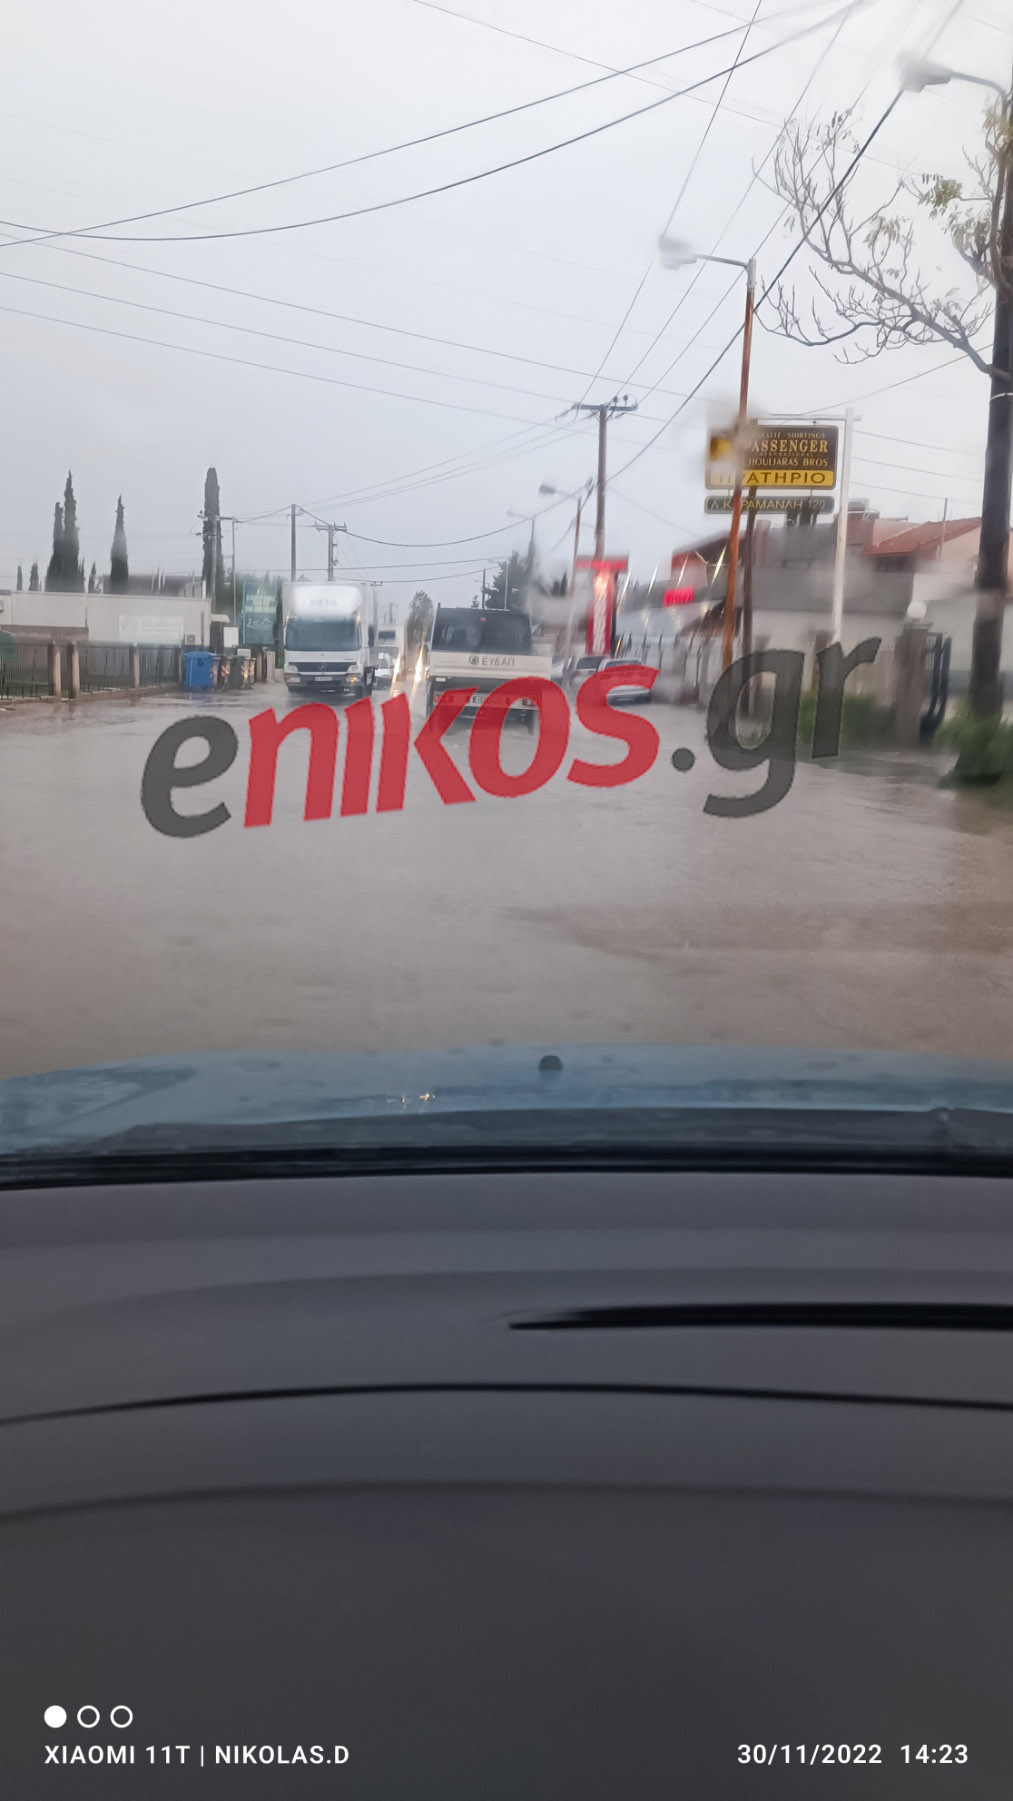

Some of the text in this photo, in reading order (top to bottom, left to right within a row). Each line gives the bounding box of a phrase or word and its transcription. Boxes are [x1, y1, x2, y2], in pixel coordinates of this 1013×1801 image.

[744, 439, 828, 452] PASSENGER
[747, 457, 828, 467] HOULIARAS BROS
[719, 471, 826, 484] ΠΑΤΗΡΙΟ
